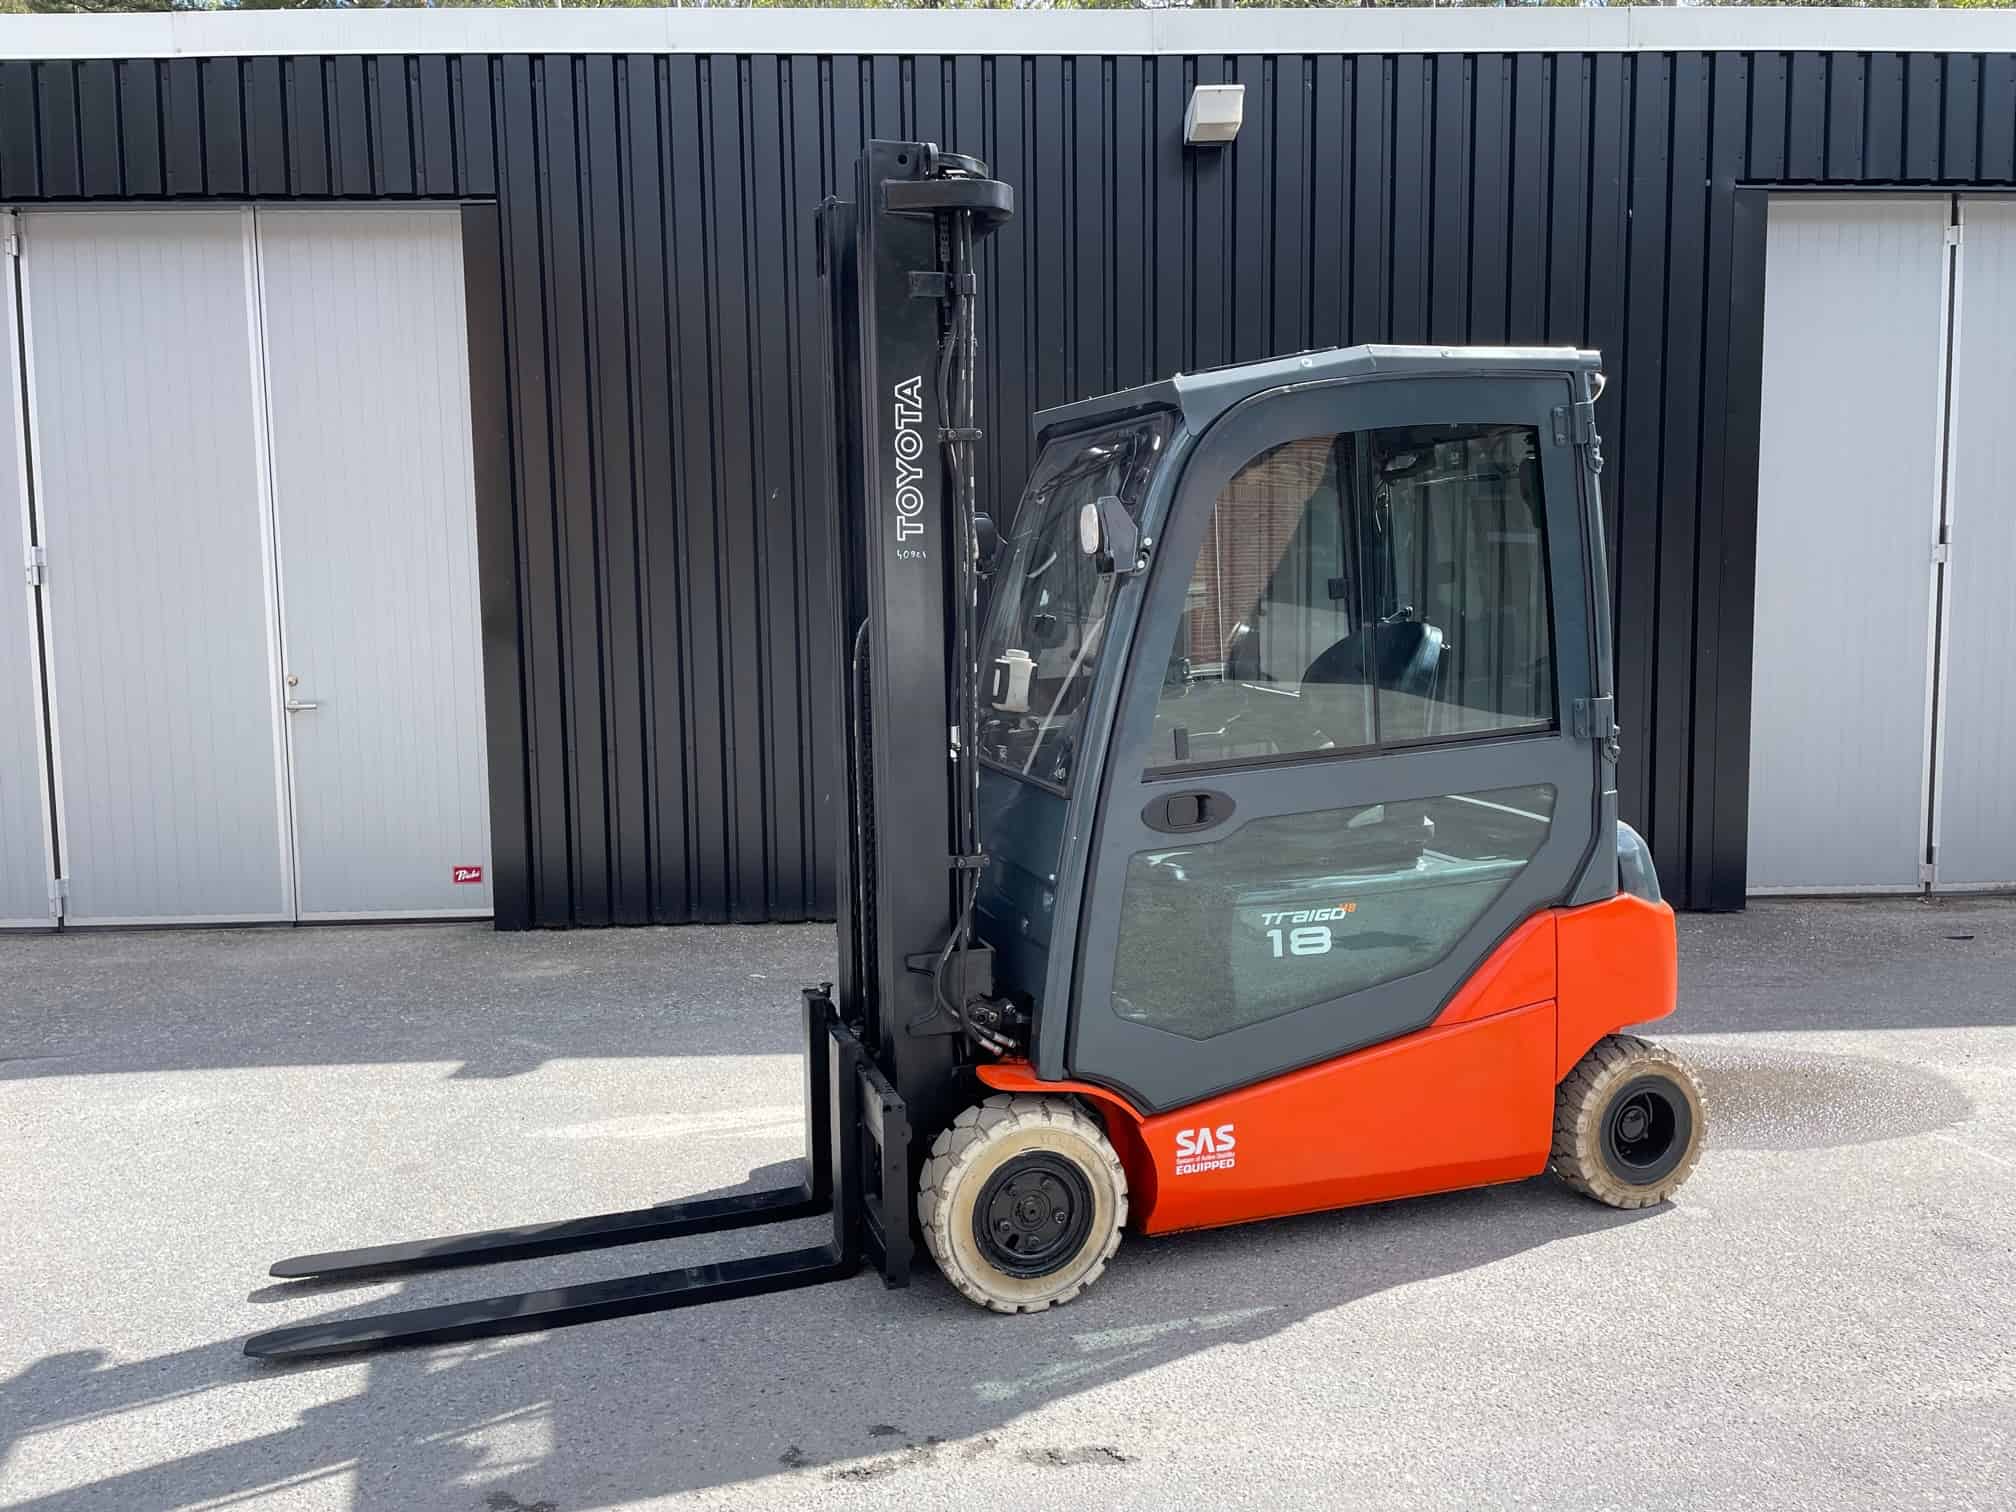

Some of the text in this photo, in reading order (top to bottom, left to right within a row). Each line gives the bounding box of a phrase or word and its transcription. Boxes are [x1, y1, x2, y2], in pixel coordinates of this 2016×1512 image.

[894, 375, 924, 542] TOYOTA
[1266, 926, 1332, 958] 18
[1175, 1123, 1236, 1157] SAS
[1175, 1158, 1236, 1176] EQUIPPED
